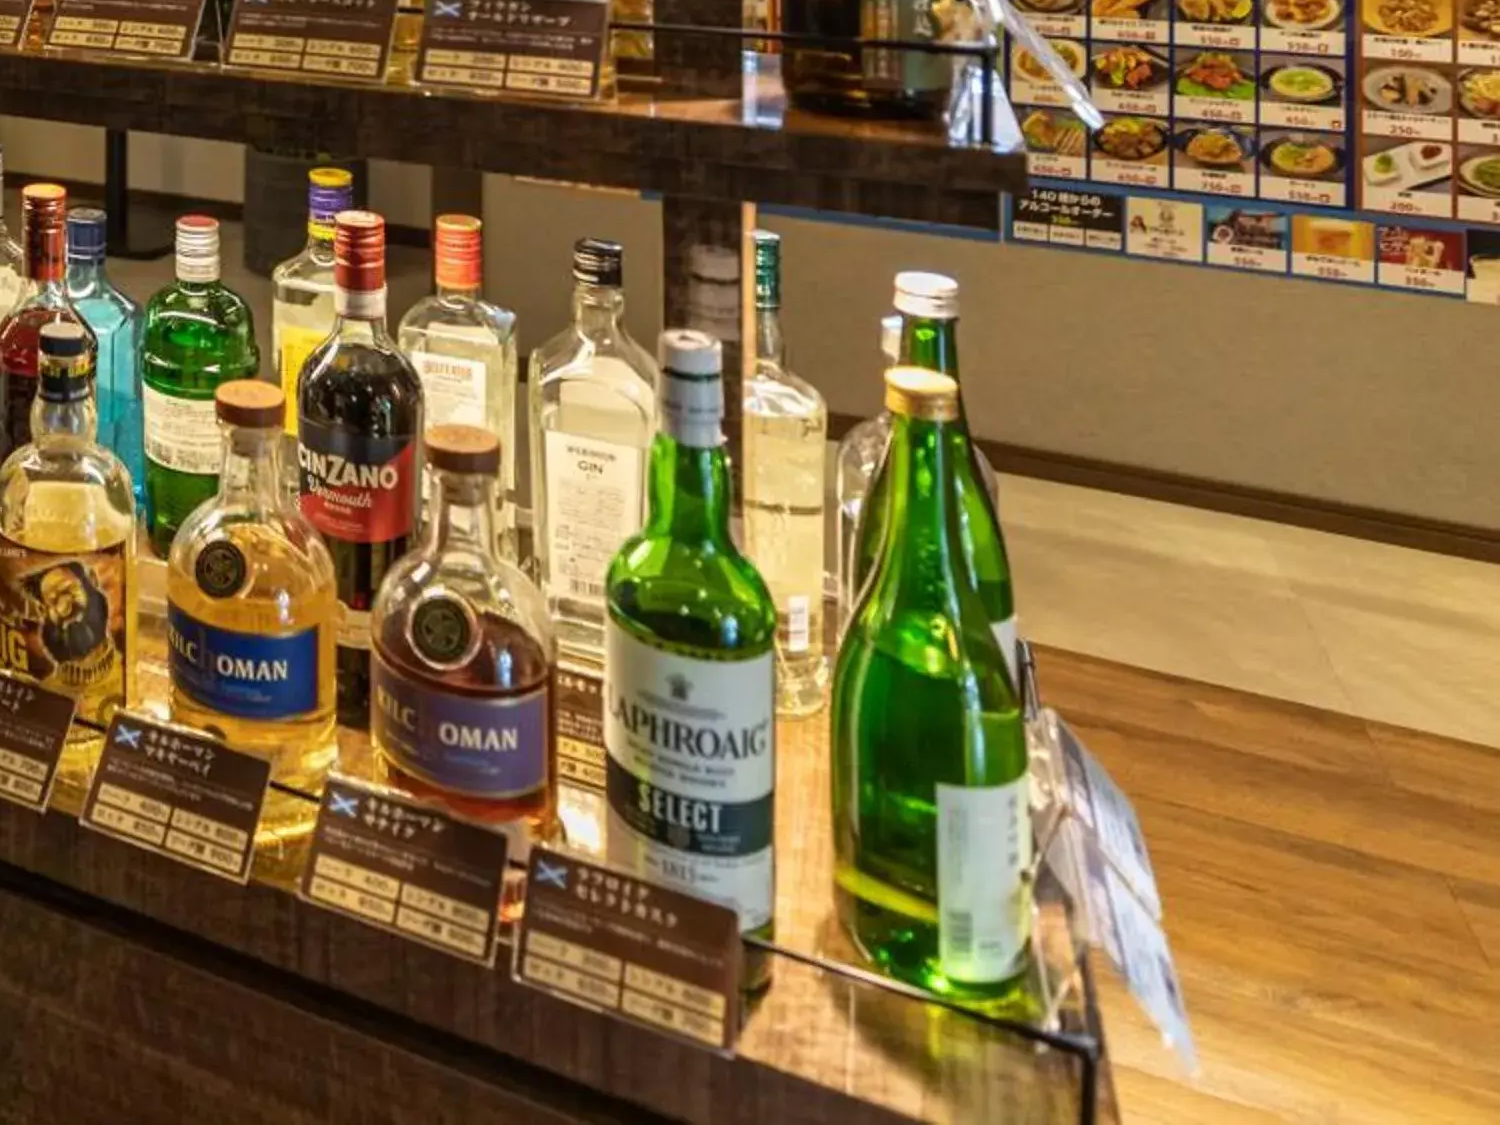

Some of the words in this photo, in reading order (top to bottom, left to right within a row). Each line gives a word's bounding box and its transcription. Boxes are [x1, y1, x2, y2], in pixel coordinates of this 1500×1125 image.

[299, 442, 399, 491] CINZANO
[577, 459, 605, 475] GIN
[638, 782, 723, 834] SELECT
